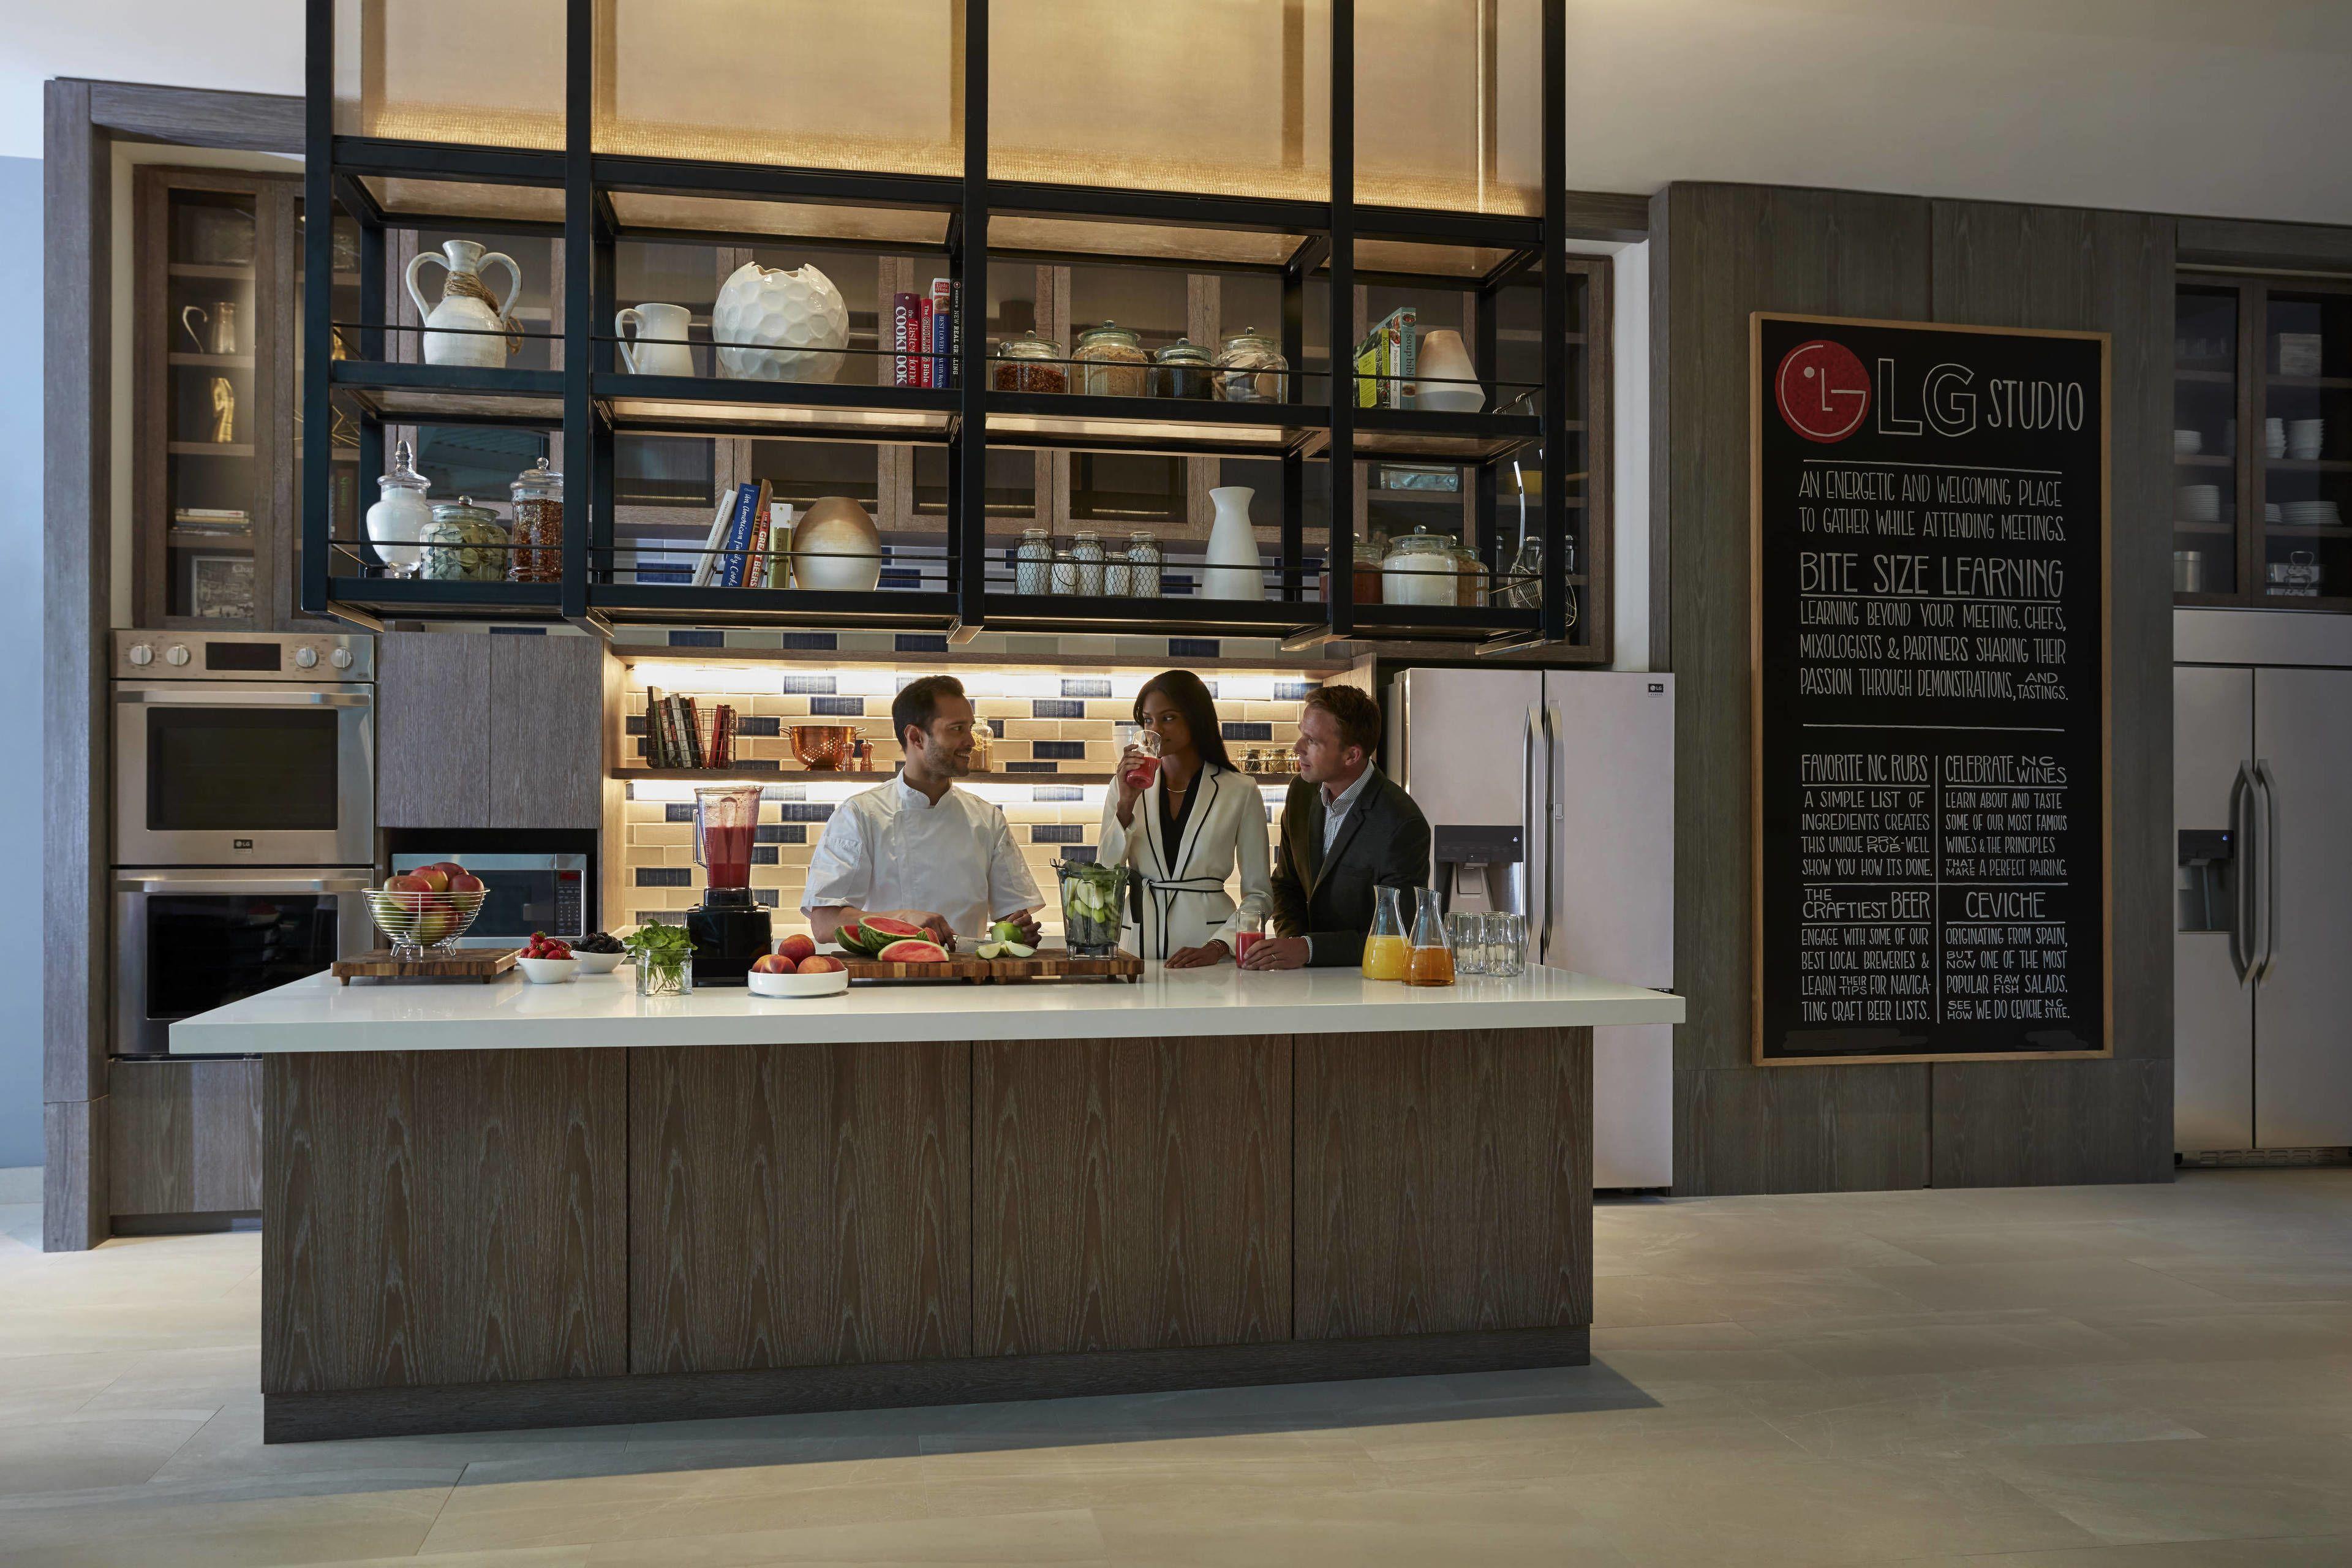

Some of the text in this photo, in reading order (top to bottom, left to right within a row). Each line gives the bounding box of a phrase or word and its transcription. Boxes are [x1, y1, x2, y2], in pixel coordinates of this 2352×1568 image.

[909, 321, 919, 347] Taste
[1403, 334, 1414, 376] soup bibl
[1878, 358, 2083, 437] LG STUDIO
[1799, 471, 2062, 507] AN ENERGETIC AND WELCOMING PLACE
[744, 494, 752, 504] An
[737, 505, 750, 540] American
[1799, 507, 2065, 541] TO GATHER WHILE ATTENDING MEETINGS.
[750, 560, 761, 587] BEERS
[1801, 552, 2063, 597] BITE SIZE LEARNING
[1801, 601, 2066, 631] LEARNING BEYOND YOUR MEETING. CHEFS,
[1801, 634, 2065, 663] MIXOLOGISTS & PARTNERS SHARING THEIR
[1801, 668, 2068, 701] PASSION THROUGH DEMONSTRATIONS, AND TASTINGS.
[1802, 754, 1928, 782] FAVORITE NC RUBS
[1946, 755, 2067, 783] CELEBRATE NC WINES
[1804, 791, 1924, 808] A SIMPLE LIST OF
[1946, 792, 2062, 809] LEARN ABOUT AND TASTE
[1803, 813, 1929, 830] INGREDIENTS CREATES
[1946, 814, 2067, 831] SOME OF OUR MOST FAMOUS
[1801, 836, 1825, 853] THIS
[1829, 836, 1863, 853] UNIQUE
[1866, 835, 1899, 844] DRY
[1867, 843, 1901, 853] RUB
[1946, 836, 2055, 853] WINES & THE PRINCIPLES
[1802, 859, 1932, 876] SHOW YOU HOW ITS DONE.
[1946, 867, 1975, 876] MAKE
[1980, 859, 1986, 876] A
[1989, 859, 2026, 876] PERFECT
[1803, 889, 1930, 918] THE CRAFTIEST BEER
[1966, 892, 2045, 918] CEVICHE
[1802, 928, 1928, 946] ENGAGE WITH SOME OF OUR
[1946, 927, 2067, 948] ORIGINATING FROM SPAIN,
[1802, 951, 1929, 970] BEST LOCAL BREWERIES &
[1947, 951, 2067, 969] BUT NOW ONE OF THE MOST
[1803, 976, 1836, 995] LEARN
[1839, 986, 1867, 995] TIPS
[1840, 976, 1866, 986] THEIR
[1871, 975, 1887, 995] FOR
[1947, 974, 2067, 993] POPULAR RAW FISH SALADS.
[1802, 1000, 1929, 1022] TING CRAFT BEER LISTS.
[1948, 1001, 1971, 1009] SEE
[1976, 1000, 1991, 1019] WE
[1994, 1000, 2007, 1019] DO
[2011, 1000, 2042, 1019] CEVICHE
[2045, 1007, 2070, 1018] STYLE.
[1948, 1011, 1972, 1019] HOW
